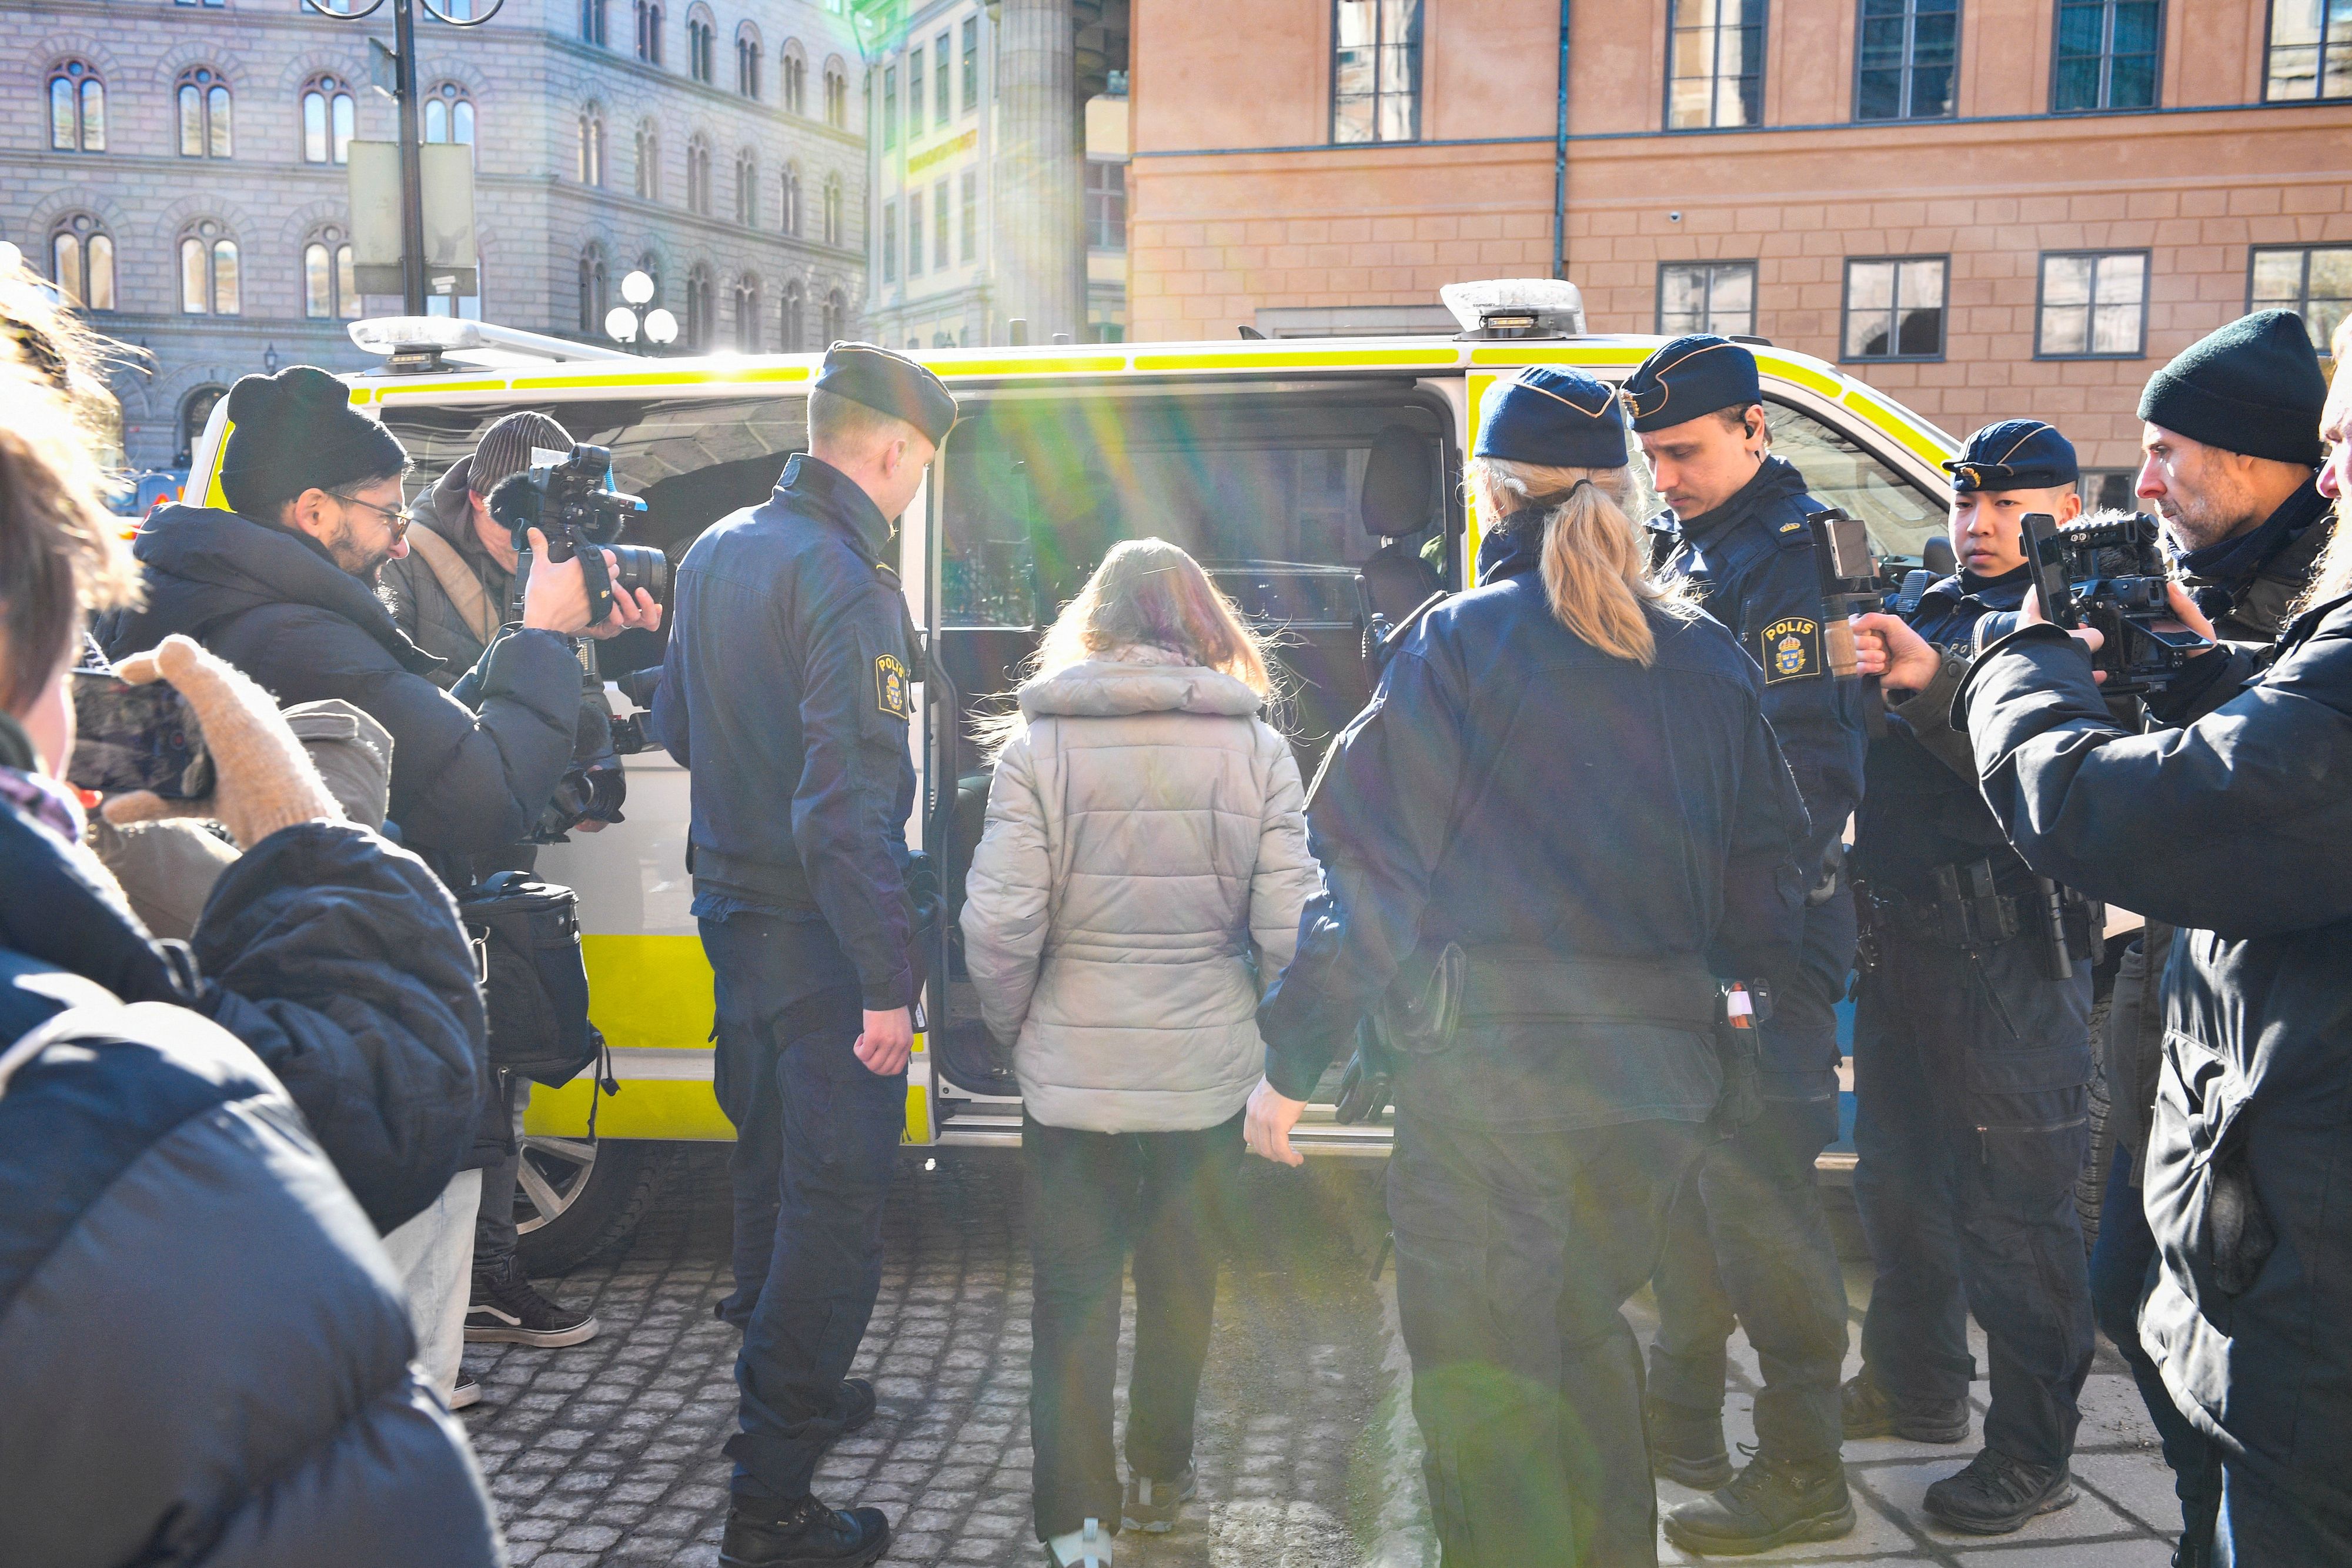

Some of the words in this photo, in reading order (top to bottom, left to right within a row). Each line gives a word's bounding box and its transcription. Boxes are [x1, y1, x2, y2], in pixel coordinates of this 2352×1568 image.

[1765, 621, 1813, 641] POLIS
[1950, 643, 1972, 654] PO
[878, 657, 904, 678] POLIS
